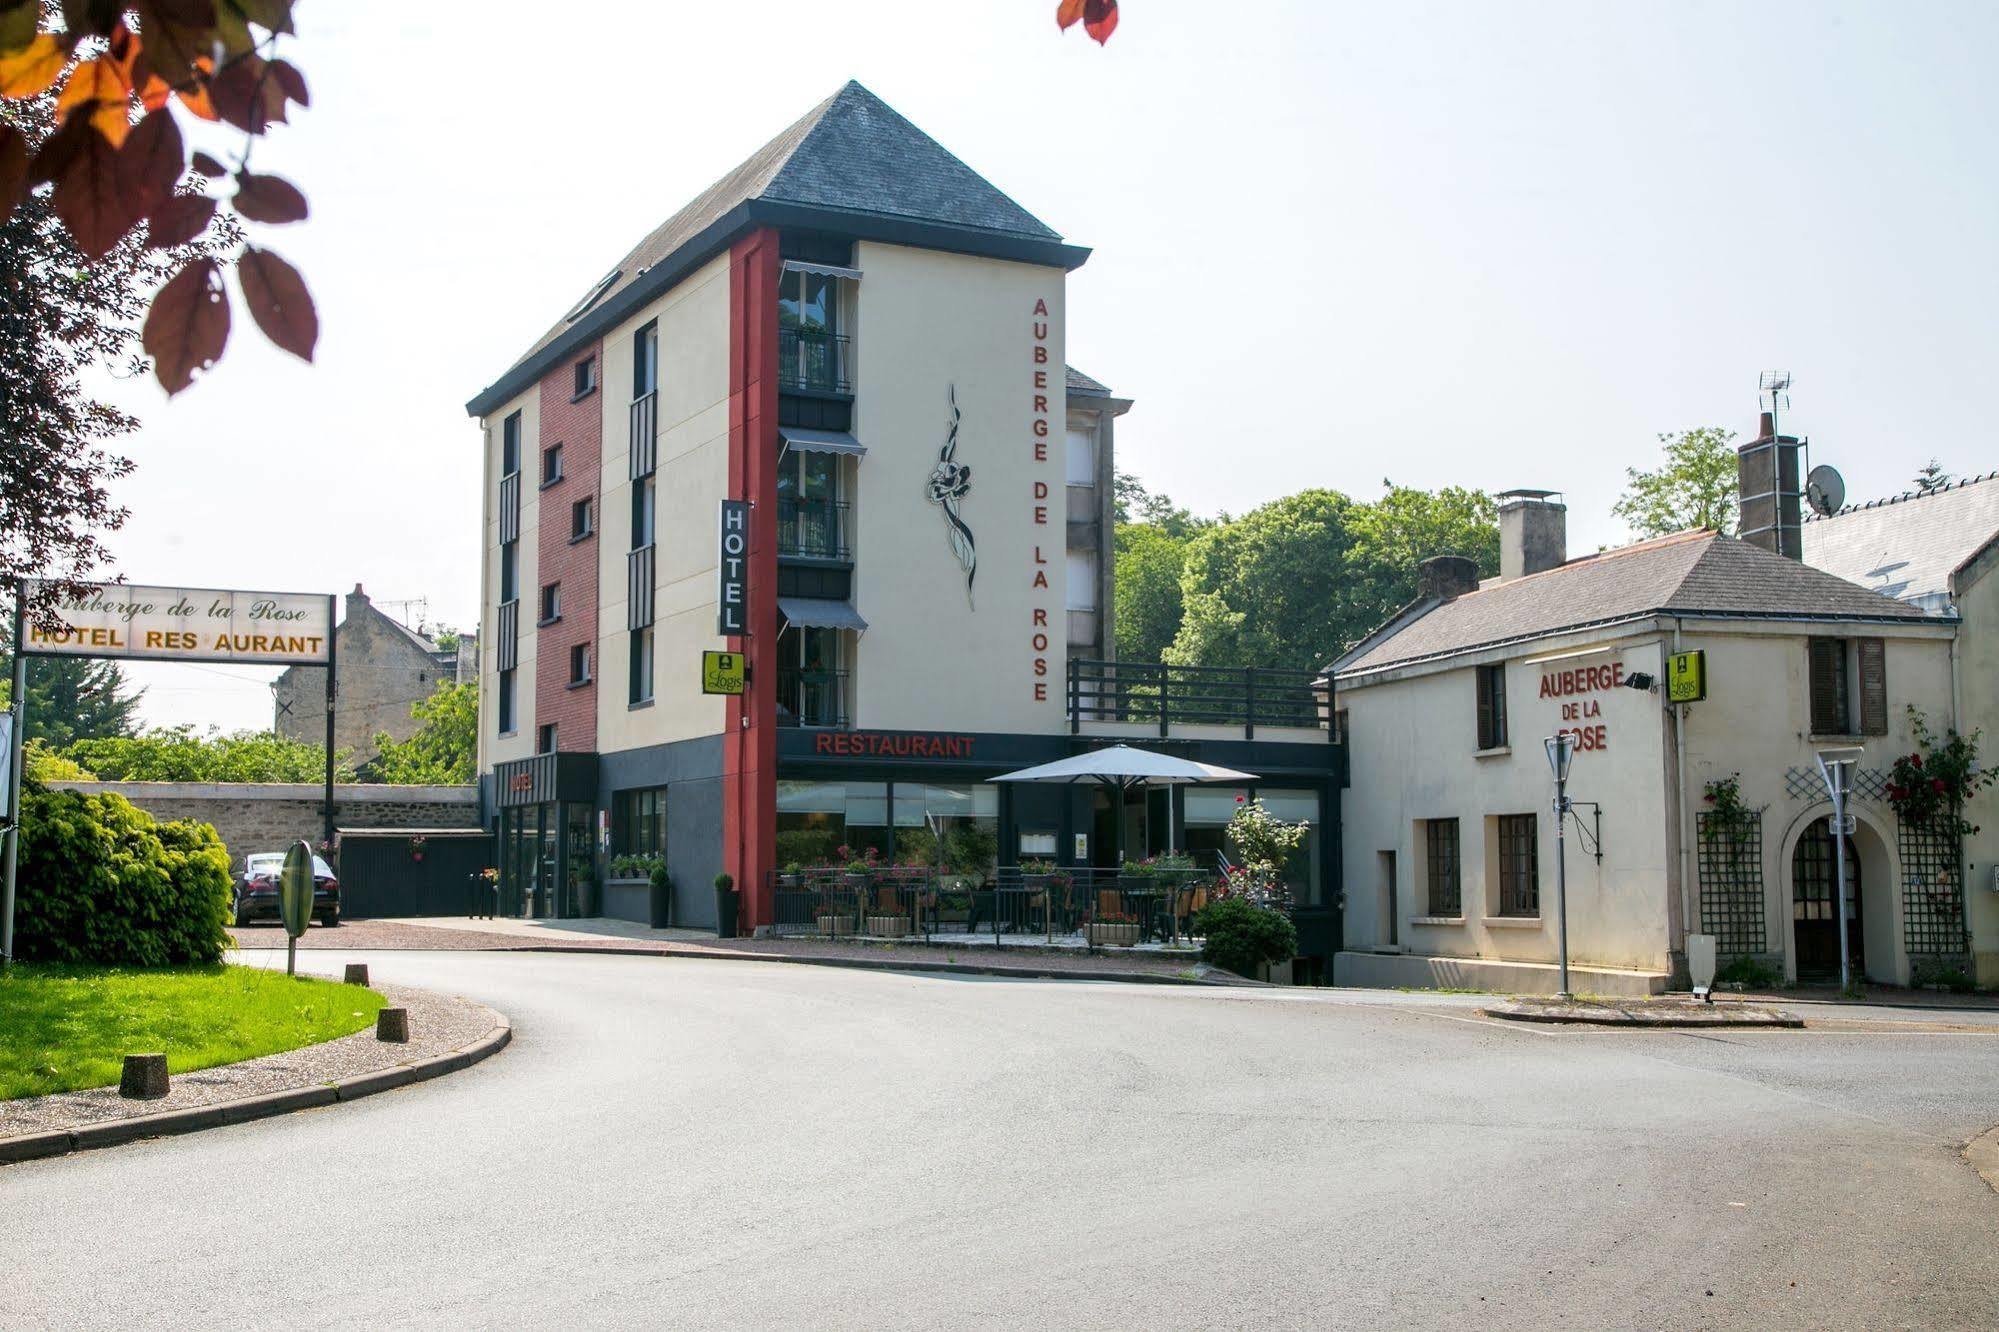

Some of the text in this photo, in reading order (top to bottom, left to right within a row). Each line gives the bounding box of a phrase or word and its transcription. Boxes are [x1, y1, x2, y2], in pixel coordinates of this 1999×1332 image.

[1033, 298, 1048, 702] AUBERGE DE LA ROSE
[724, 509, 744, 628] HOTEL
[167, 598, 199, 616] de
[207, 600, 234, 618] la
[249, 600, 309, 621] Rose
[708, 670, 742, 691] Logis
[1540, 663, 1624, 698] AUBERGE
[1671, 674, 1695, 697] Logis
[1562, 699, 1601, 720] DE LA
[816, 733, 976, 756] RESTAURANT
[1559, 725, 1607, 752] OSE
